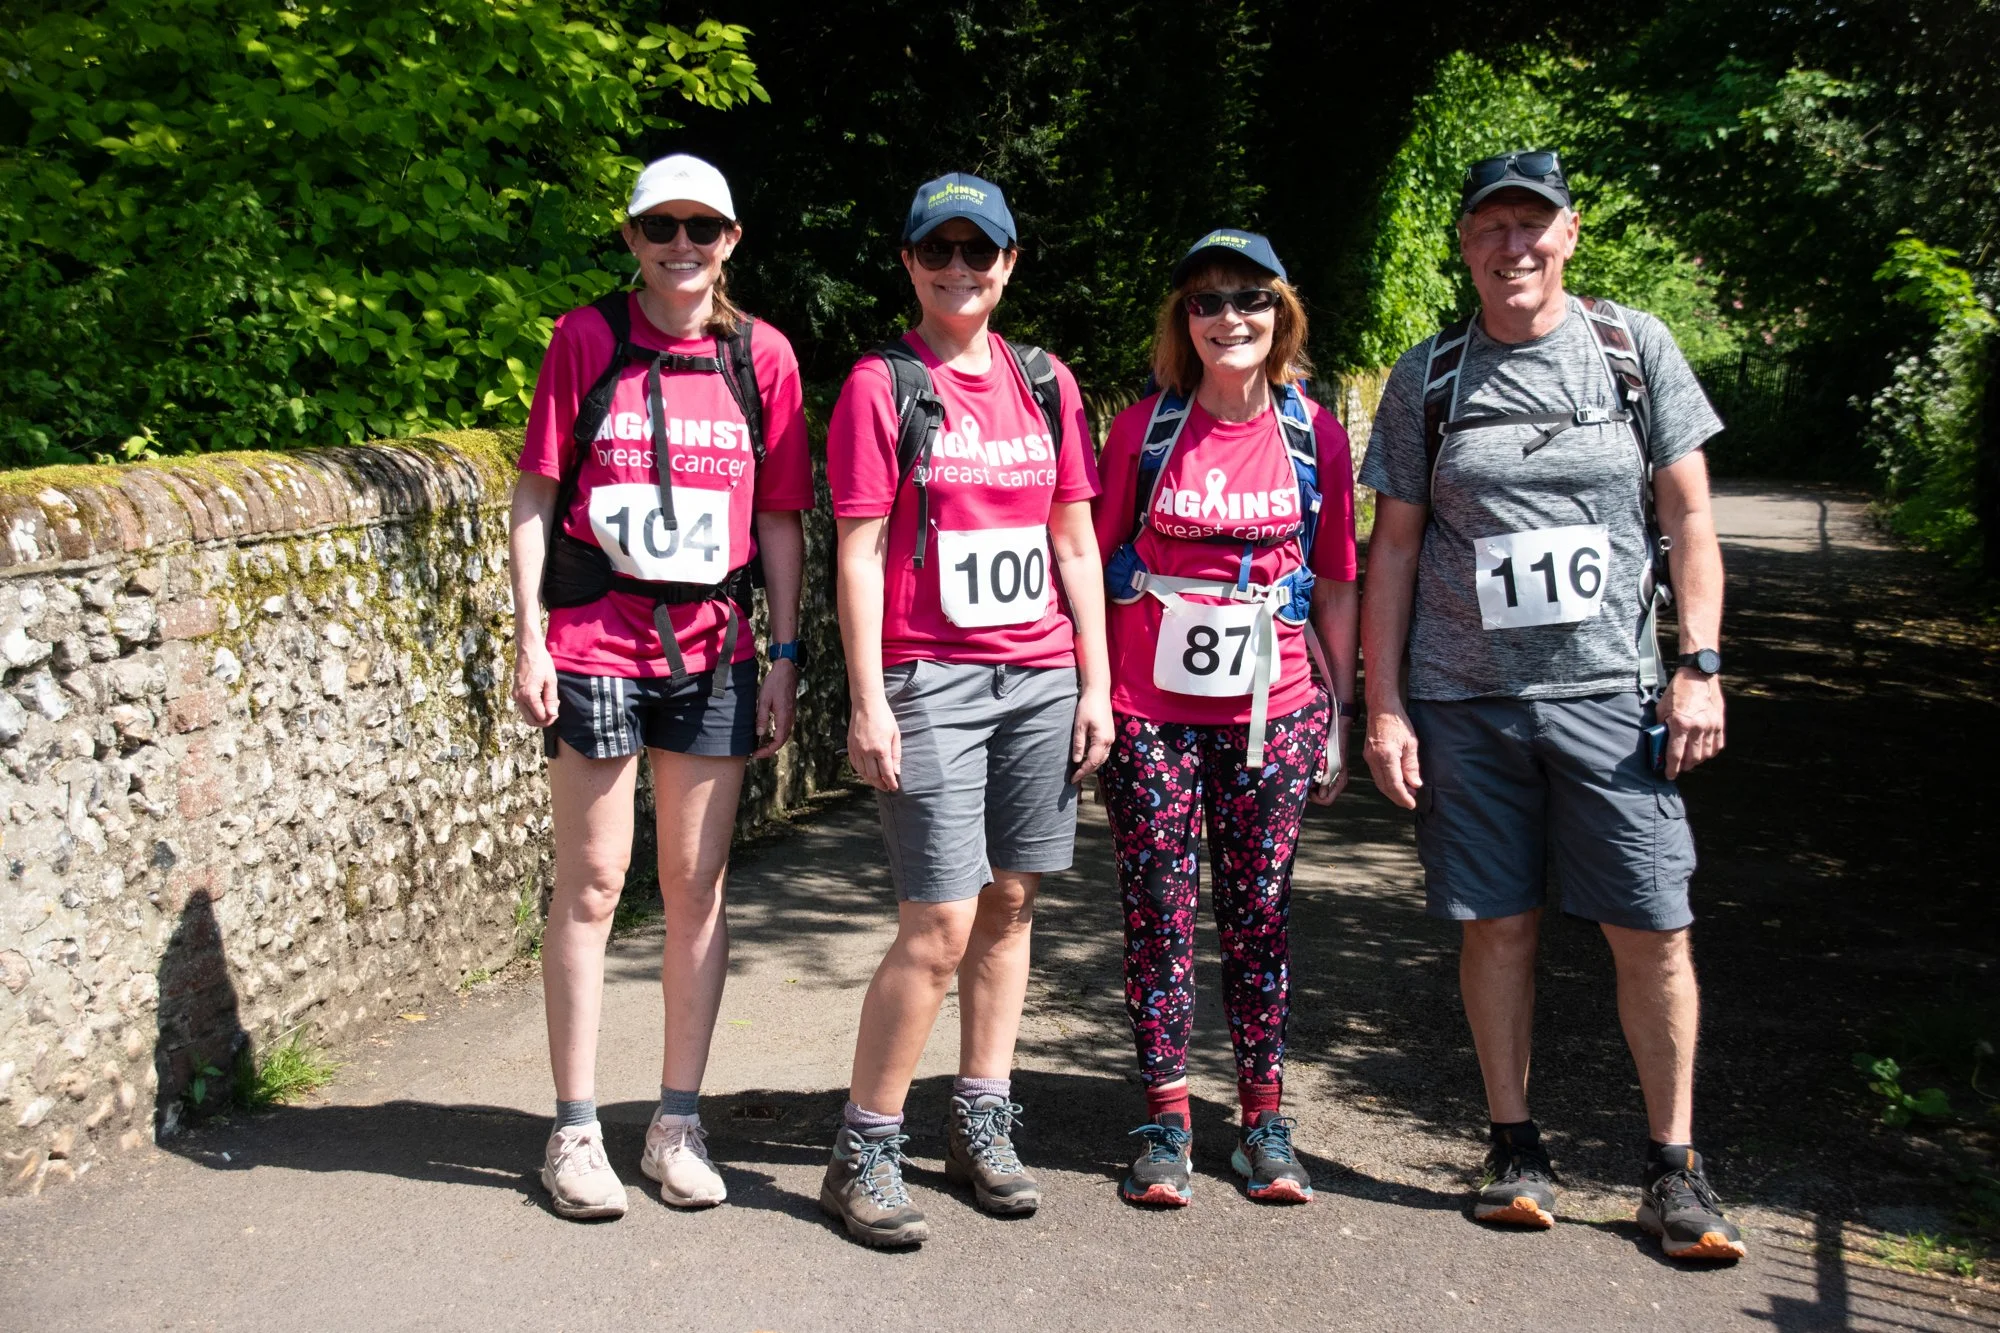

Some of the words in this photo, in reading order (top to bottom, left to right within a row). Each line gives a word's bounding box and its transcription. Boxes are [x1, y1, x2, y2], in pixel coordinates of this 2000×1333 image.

[928, 195, 953, 210] breast
[955, 194, 984, 206] cancer
[592, 442, 661, 468] breas
[671, 453, 748, 478] cancer
[997, 468, 1057, 487] cance
[605, 505, 720, 562] 104
[1154, 514, 1224, 540] breast
[954, 547, 1045, 605] 100
[1490, 546, 1602, 608] 116
[1182, 625, 1252, 677] 87
